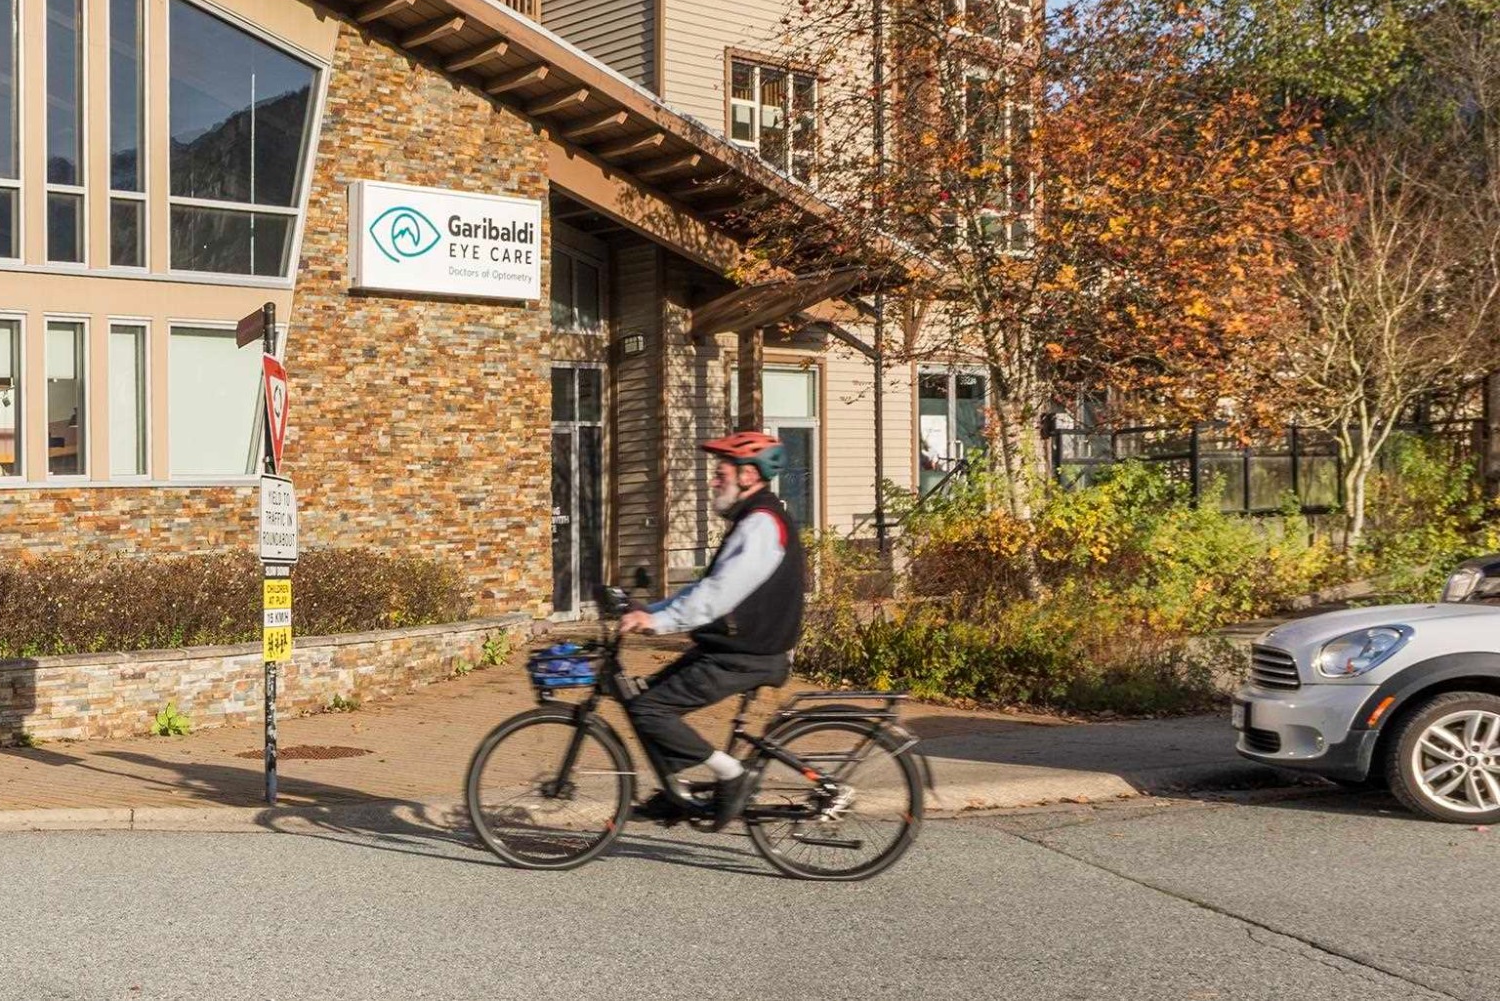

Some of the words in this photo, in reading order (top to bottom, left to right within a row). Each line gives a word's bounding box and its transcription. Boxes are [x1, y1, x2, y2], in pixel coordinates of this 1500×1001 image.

[448, 215, 534, 245] Garibaldi
[449, 243, 480, 260] EYE
[490, 247, 532, 265] CARE
[448, 266, 479, 278] Doctors
[481, 269, 490, 278] of
[492, 270, 532, 284] Optometry
[283, 492, 290, 506] TO
[265, 510, 285, 526] TRAFFIC
[263, 531, 295, 547] ROUNDABOUT
[267, 584, 289, 594] CHILDREN
[268, 596, 275, 605] AT
[276, 596, 287, 605] PLAY
[267, 613, 274, 624] 15
